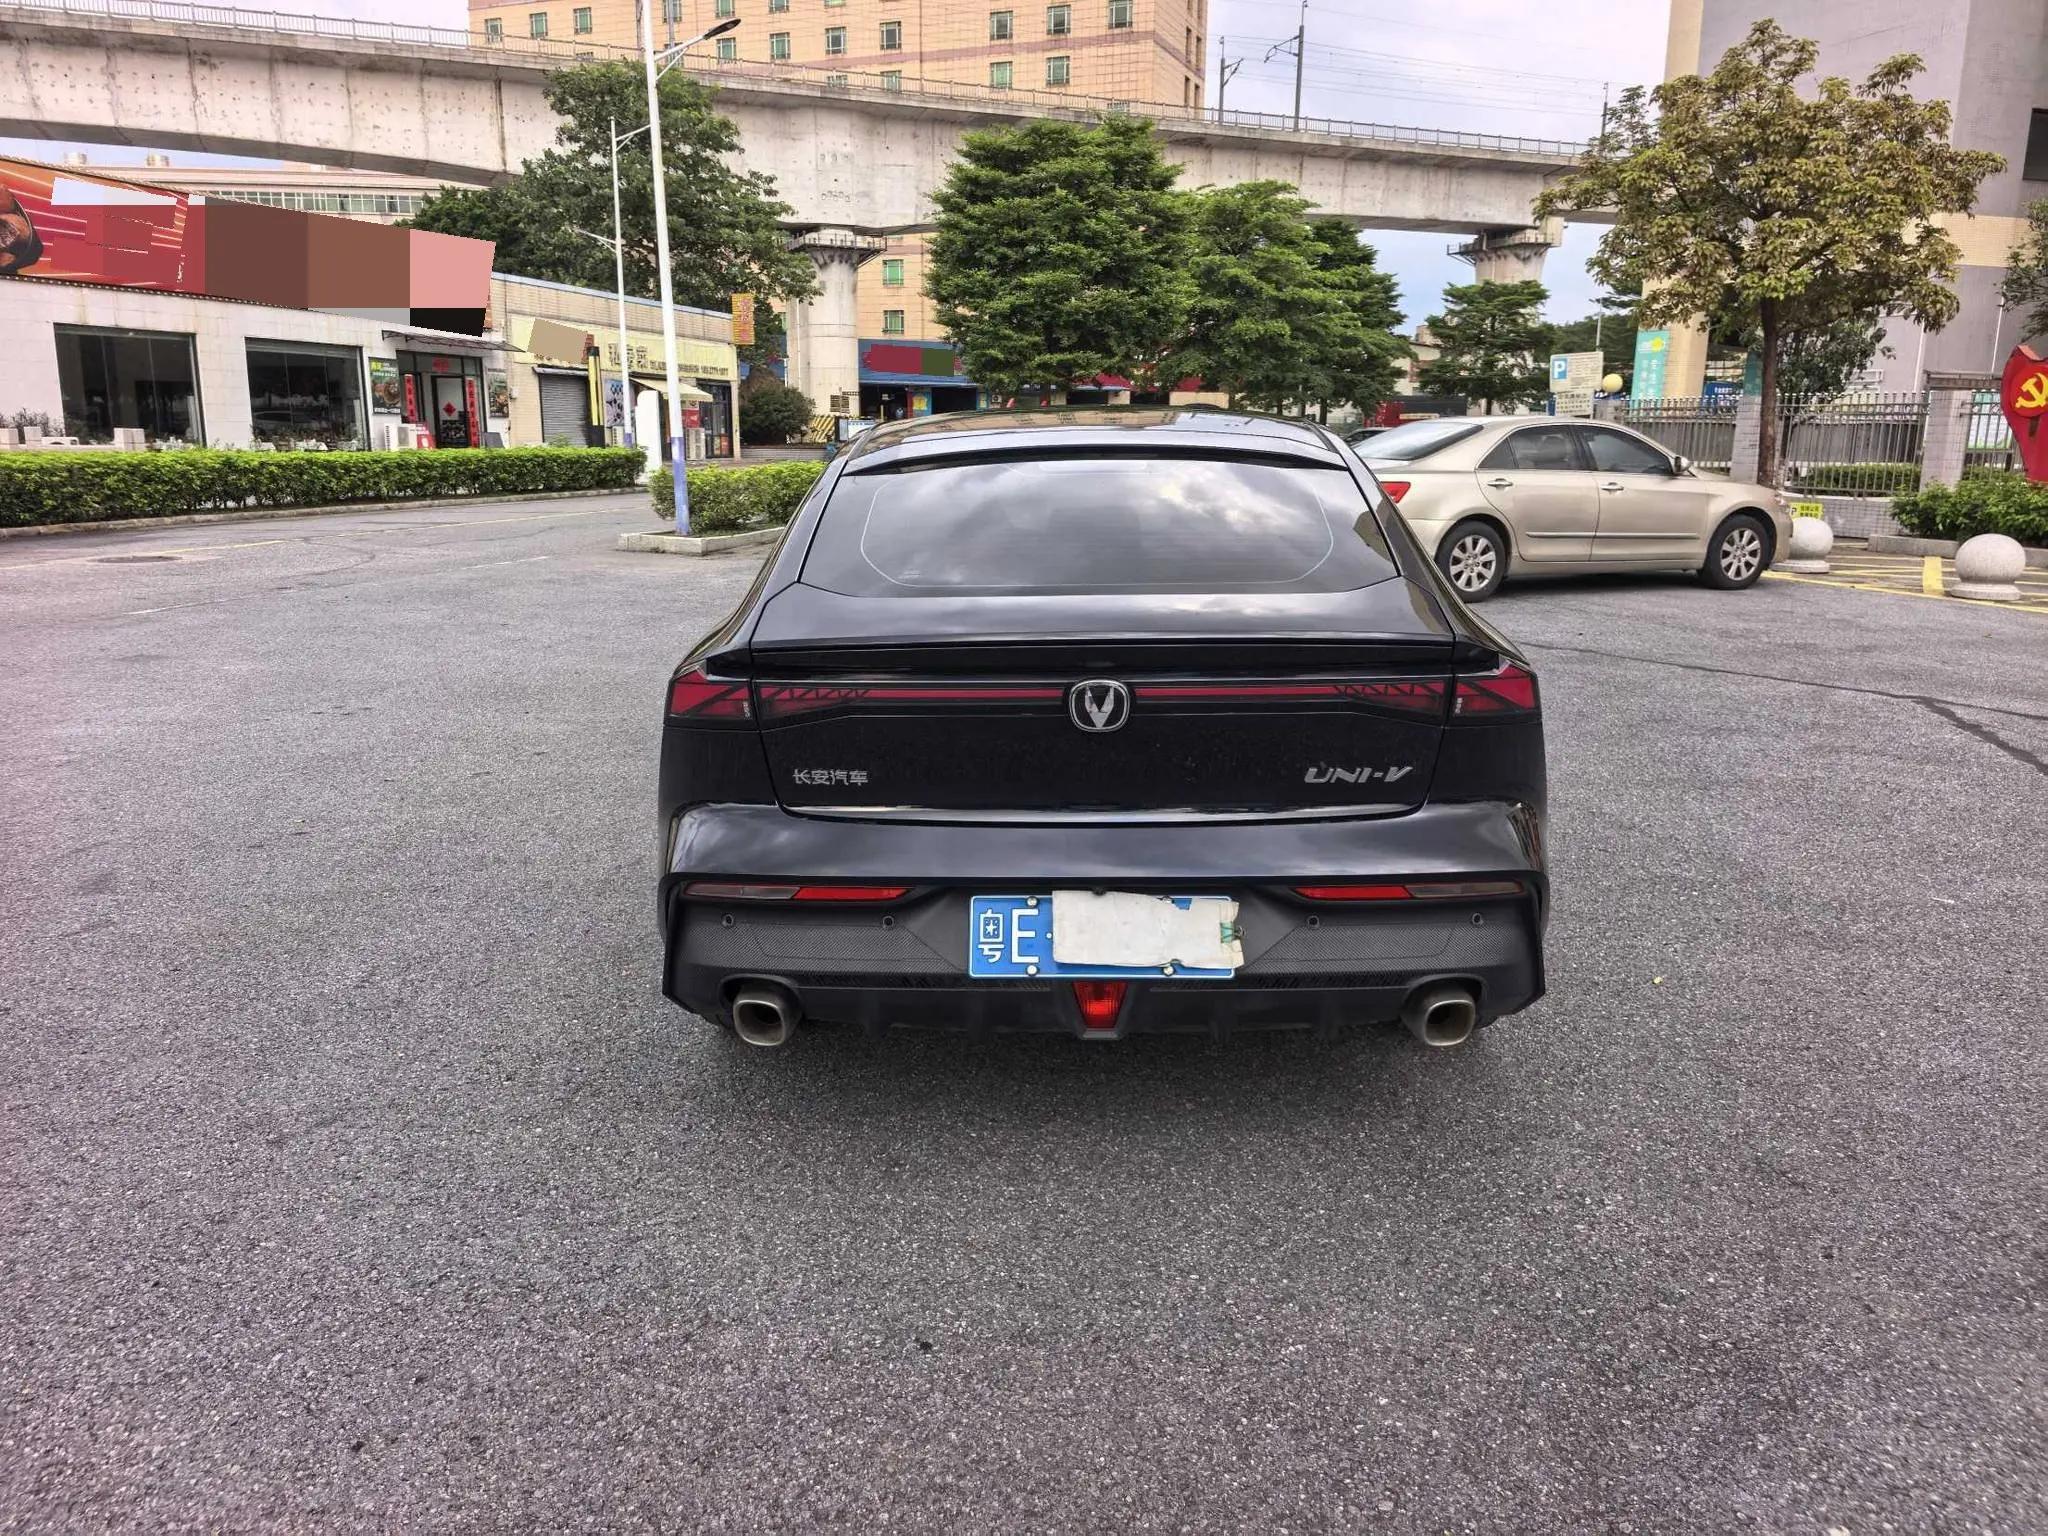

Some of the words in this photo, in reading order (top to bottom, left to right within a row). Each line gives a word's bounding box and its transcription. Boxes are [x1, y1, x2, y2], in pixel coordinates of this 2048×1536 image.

[1553, 360, 1566, 379] P
[792, 768, 869, 786] 长安汽车
[1304, 766, 1413, 783] UNI-V
